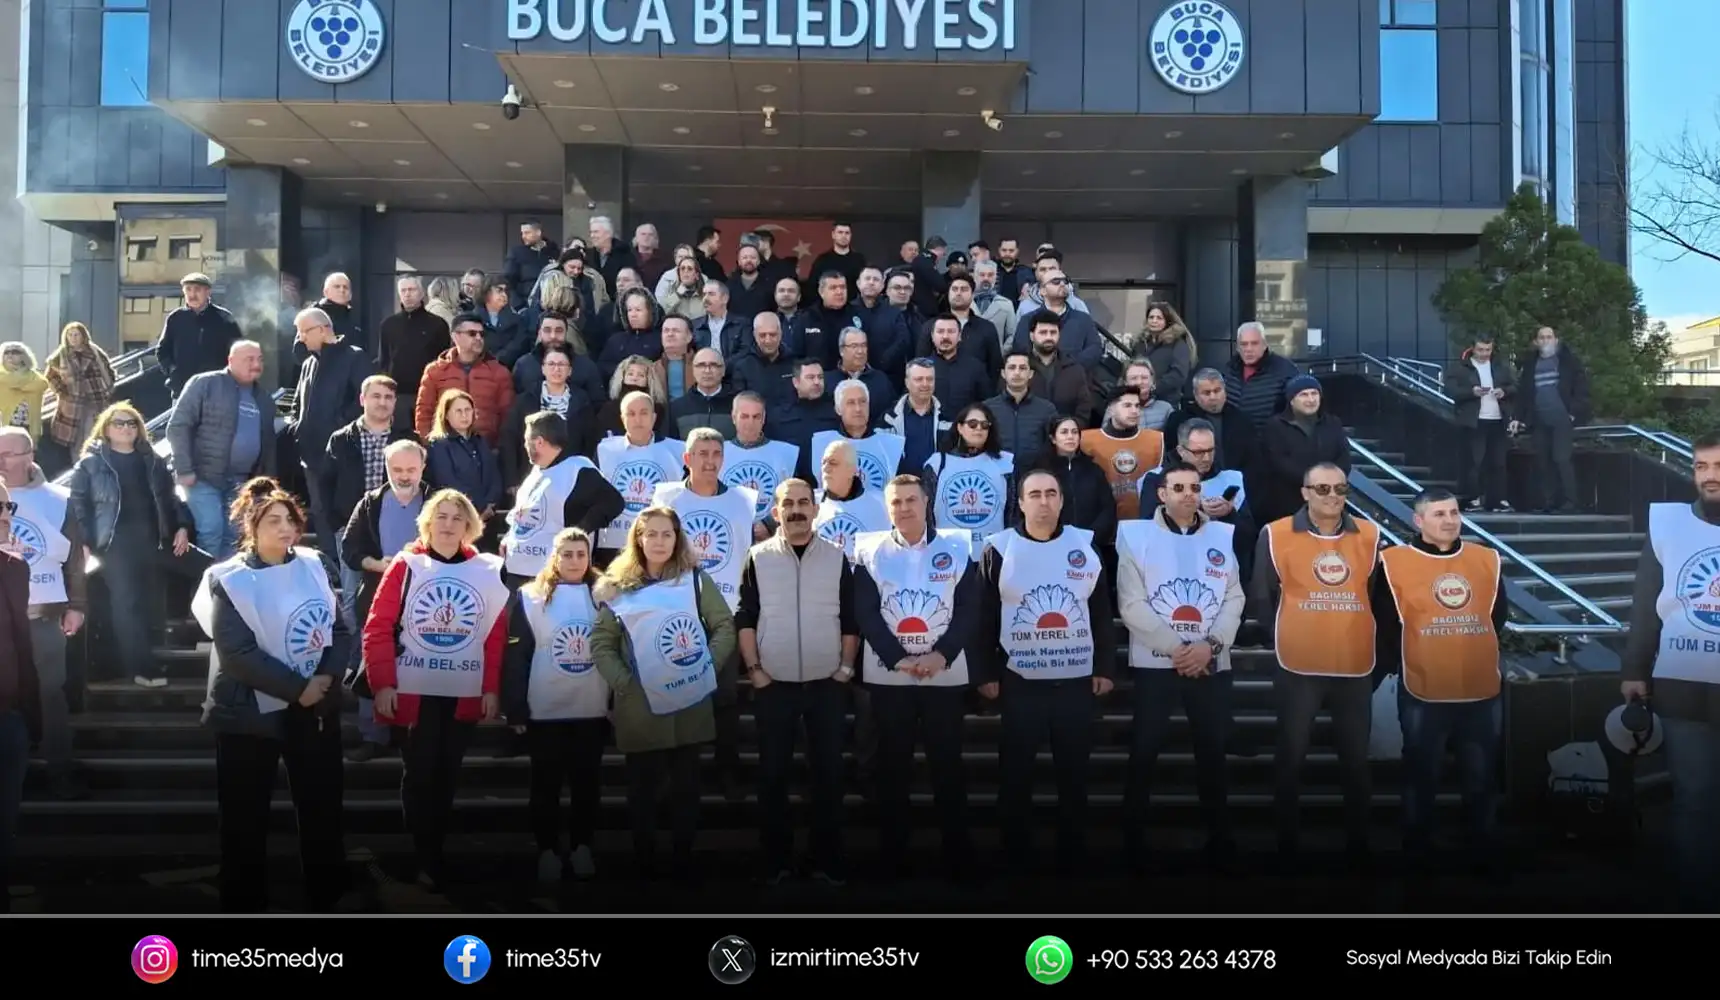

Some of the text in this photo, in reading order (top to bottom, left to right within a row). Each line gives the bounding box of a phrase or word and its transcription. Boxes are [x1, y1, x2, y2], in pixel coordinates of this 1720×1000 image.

[1170, 3, 1224, 22] BUCA
[508, 0, 676, 44] BUCA
[1034, 629, 1070, 640] YEREL
[898, 635, 929, 645] EREL
[1009, 648, 1037, 657] Emek
[1050, 659, 1065, 668] Bir
